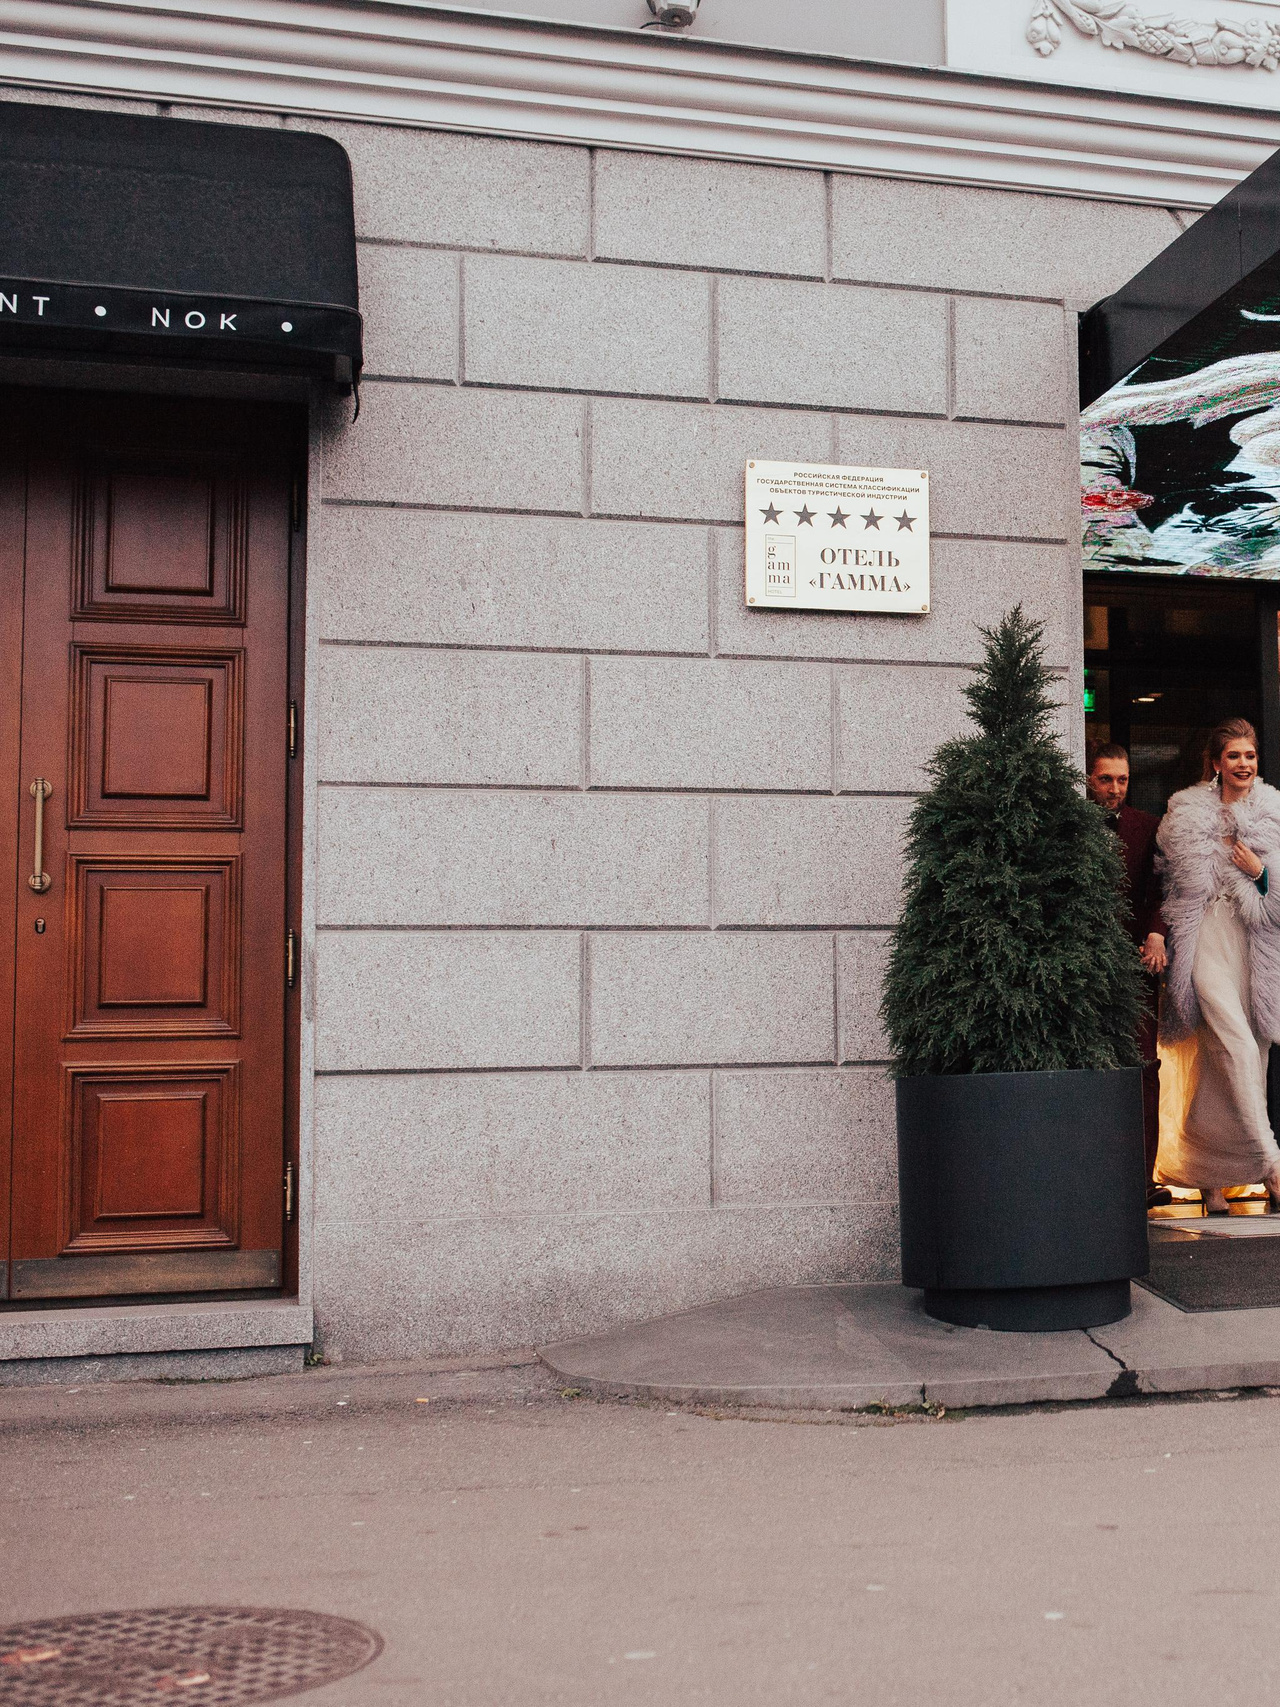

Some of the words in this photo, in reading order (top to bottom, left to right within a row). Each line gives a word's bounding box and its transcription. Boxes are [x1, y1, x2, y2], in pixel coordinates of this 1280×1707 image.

[152, 307, 237, 331] NOK
[756, 478, 824, 488] ГОСУДАРСТВЕННАЯ
[825, 482, 858, 490] СИСТЕМА
[859, 484, 920, 493] КЛАССИФИКАЦИИ
[793, 471, 840, 480] РОССИЙСКАЯ
[841, 474, 884, 483] ФЕДЕРАЦИЯ
[769, 487, 807, 496] ОБЪЕКТОВ
[808, 489, 866, 499] ТУРИСТИЧЕСКОЙ
[866, 493, 908, 501] ИНДУСТРИИ
[820, 547, 901, 568] ОТЕЛЬ
[808, 571, 911, 593] «ГАММА»
